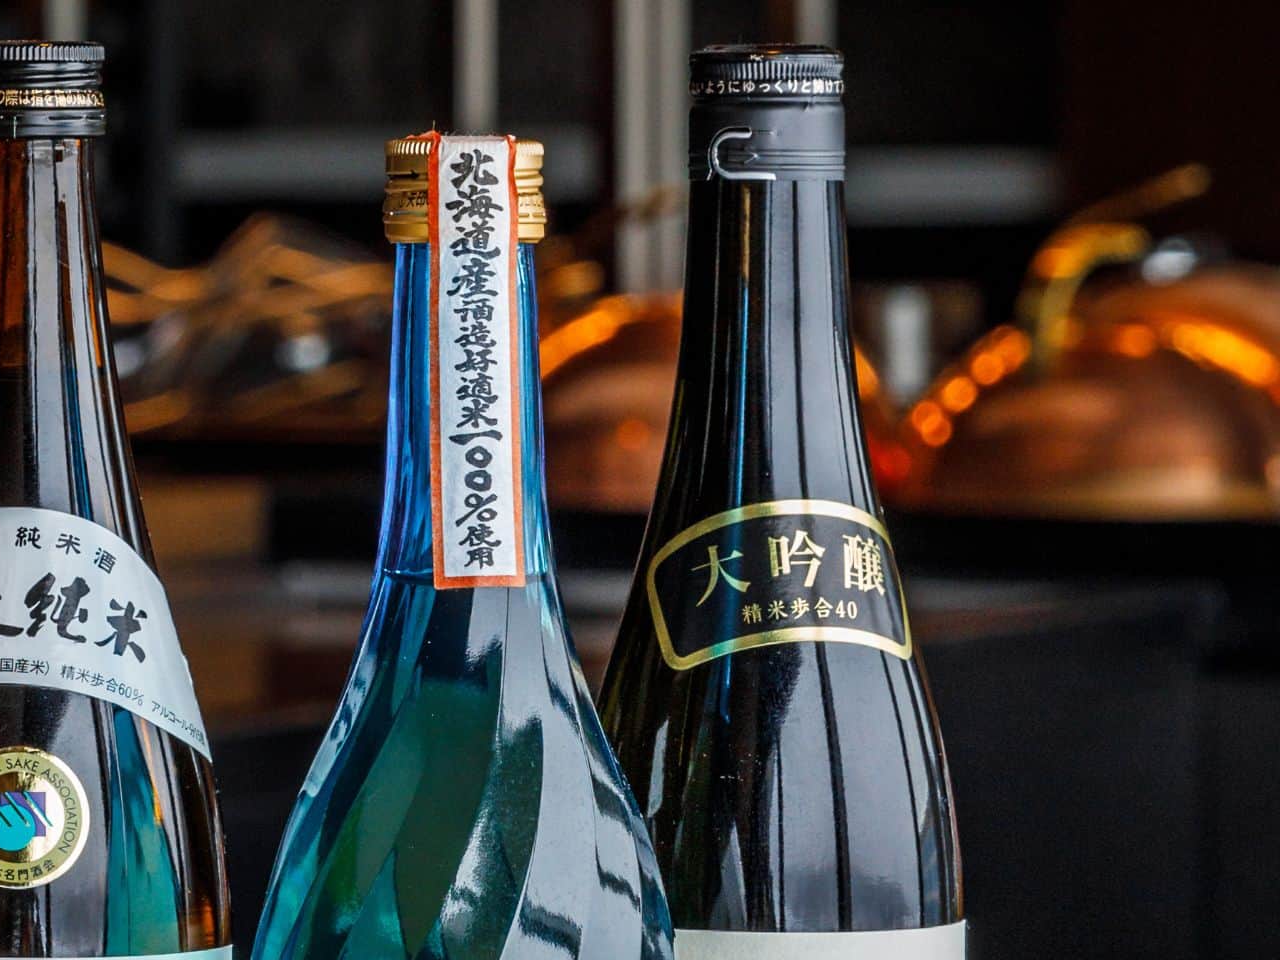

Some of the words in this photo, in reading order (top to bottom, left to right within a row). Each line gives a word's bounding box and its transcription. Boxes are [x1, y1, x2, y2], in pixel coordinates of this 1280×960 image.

[690, 530, 886, 607] 大吟醸
[742, 597, 858, 624] 精米歩合40
[6, 758, 40, 773] SAKE
[42, 767, 78, 854] ASSOCIATION
